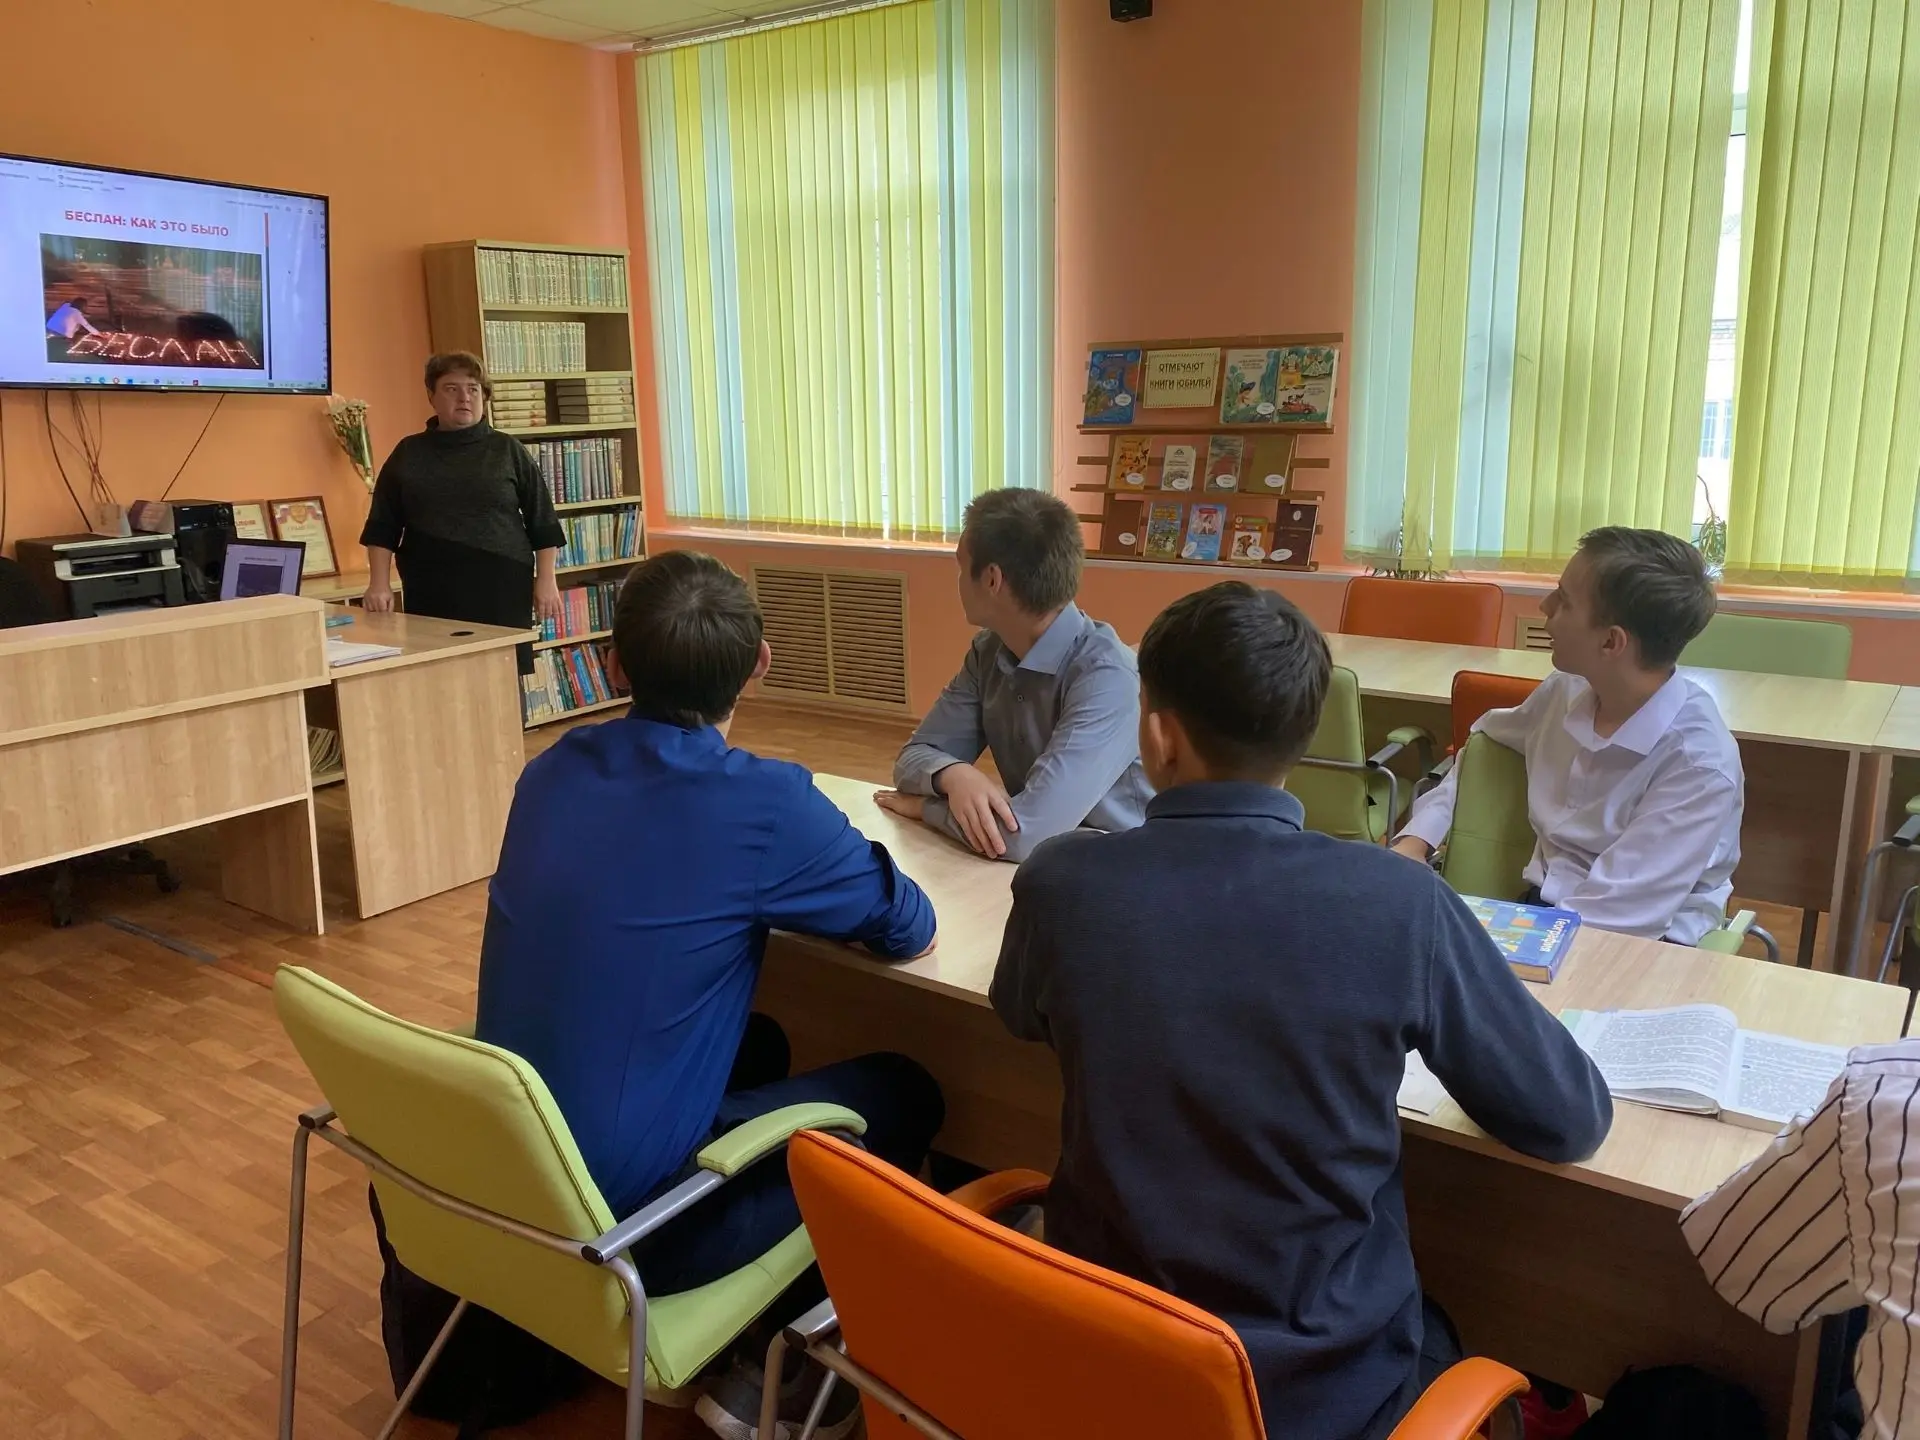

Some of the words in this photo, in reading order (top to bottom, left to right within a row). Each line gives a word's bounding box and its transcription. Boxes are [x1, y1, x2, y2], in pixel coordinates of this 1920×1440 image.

[64, 209, 127, 226] БЕСЛАН:
[130, 217, 157, 230] КАК
[160, 220, 188, 232] ЭТО
[191, 224, 230, 237] БЫЛО
[66, 331, 260, 366] БЕСЛАН
[1158, 362, 1205, 374] ОТМЕЧАЮТ
[1149, 379, 1175, 390] КНИГИ
[1176, 377, 1212, 389] ЮБИЛЕЙ
[1539, 918, 1571, 953] География
